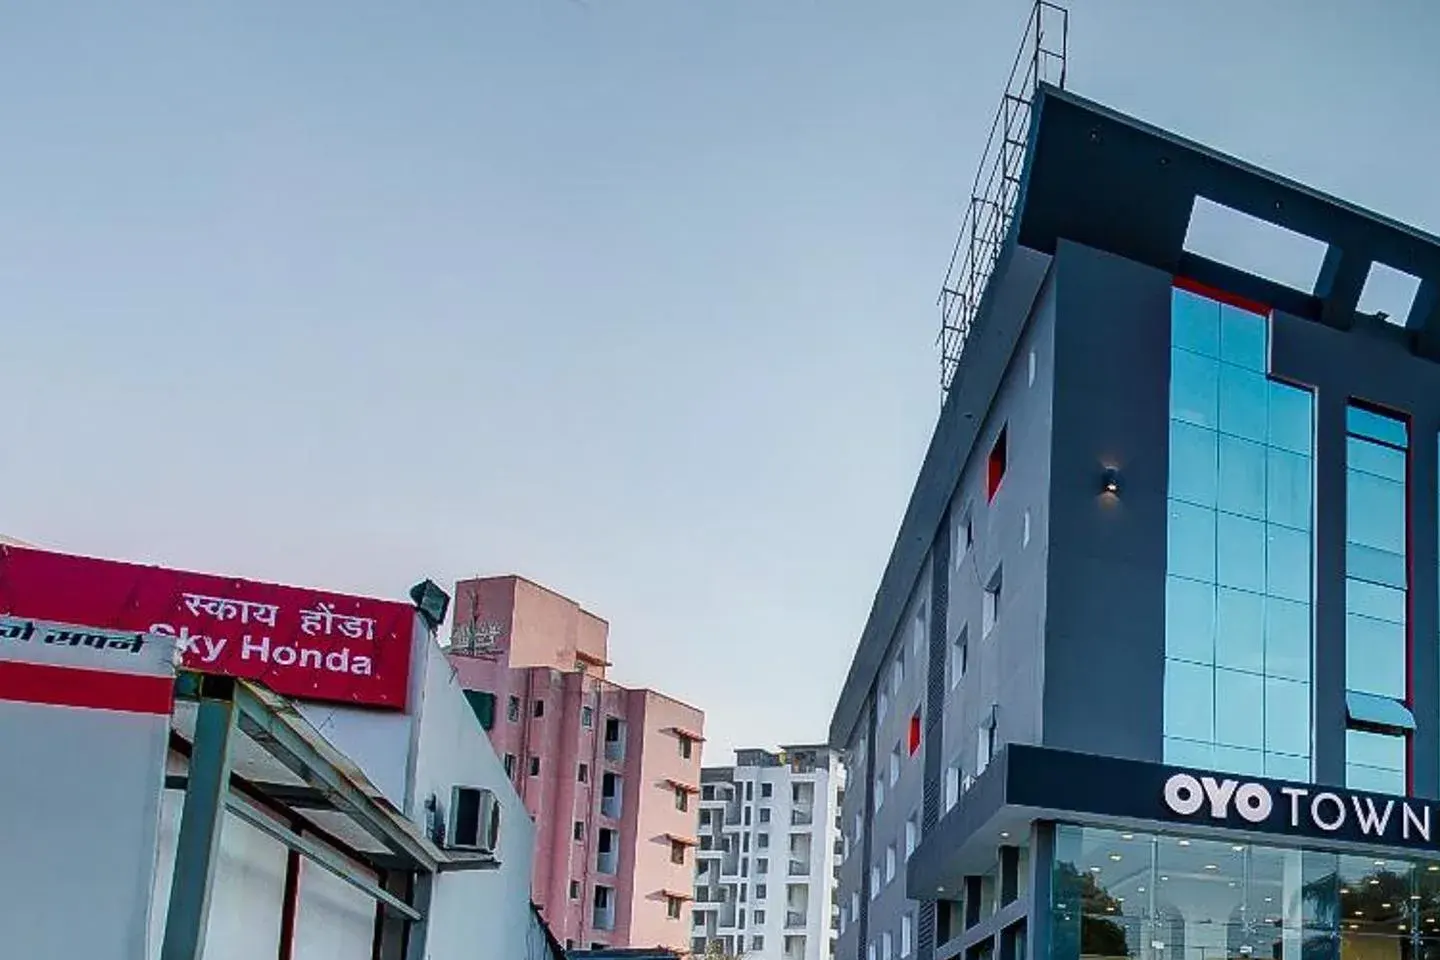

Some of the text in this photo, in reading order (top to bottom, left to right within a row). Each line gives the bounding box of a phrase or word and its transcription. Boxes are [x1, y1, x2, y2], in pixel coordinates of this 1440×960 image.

[182, 592, 280, 627] स्काय
[241, 635, 372, 675] Honda
[1164, 773, 1272, 823] OYO
